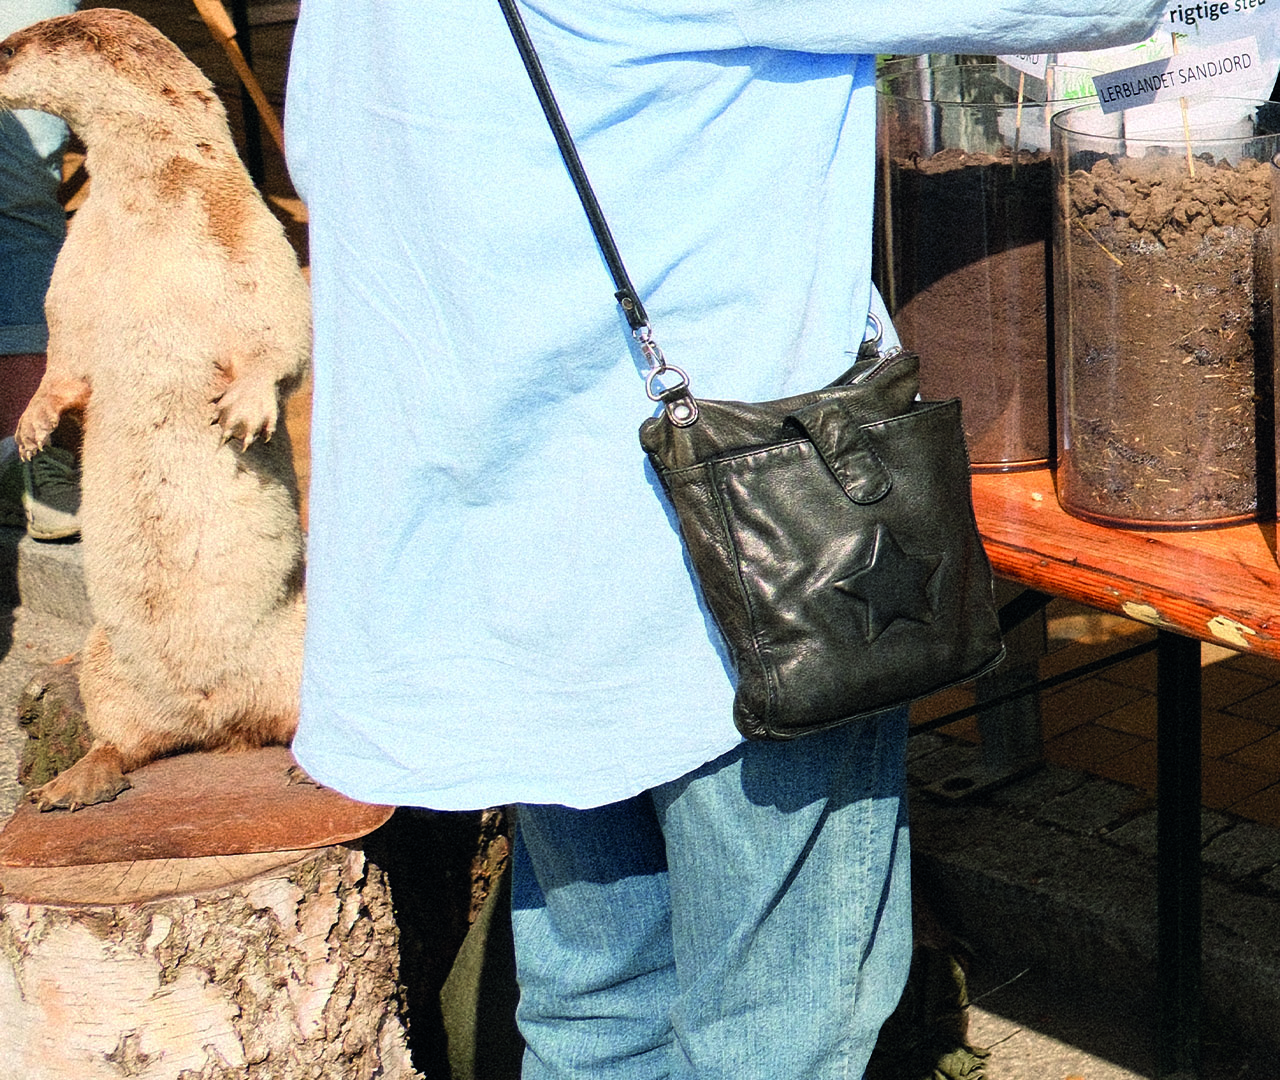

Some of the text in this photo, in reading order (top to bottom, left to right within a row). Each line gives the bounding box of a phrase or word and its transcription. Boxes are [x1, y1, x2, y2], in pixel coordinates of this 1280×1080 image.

[1169, 1, 1230, 26] rigtige
[1100, 52, 1252, 103] LERBLANDET SANDJORD
